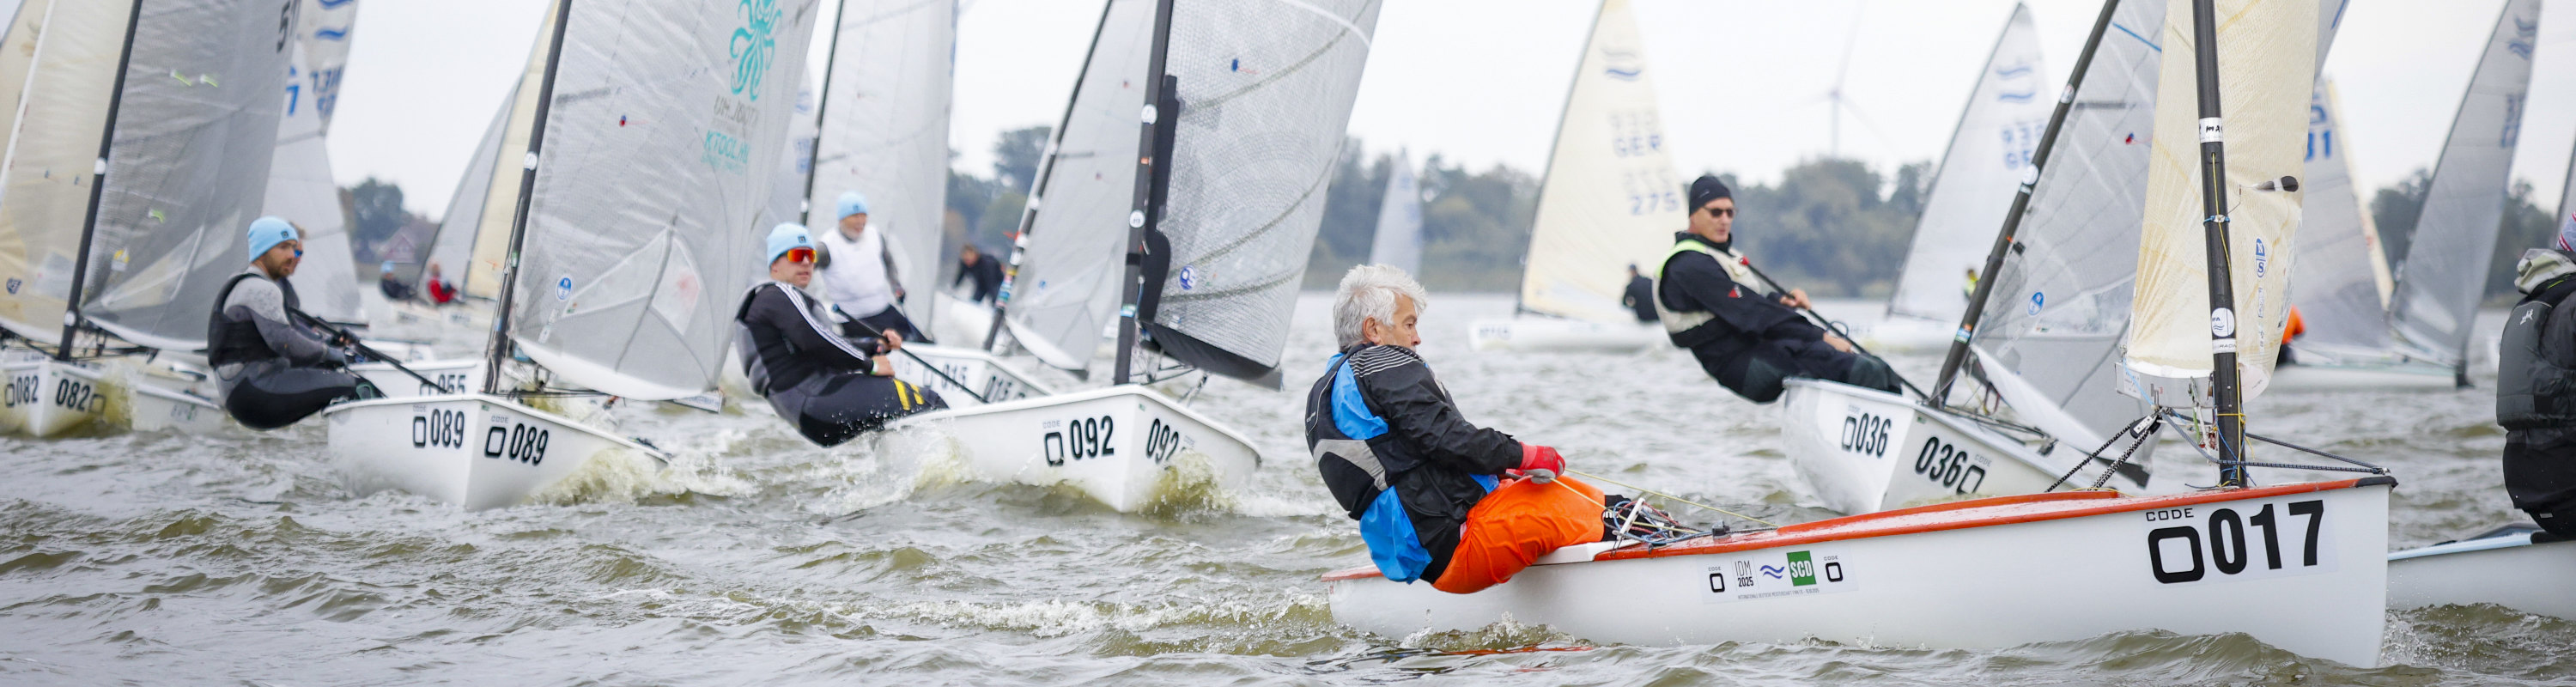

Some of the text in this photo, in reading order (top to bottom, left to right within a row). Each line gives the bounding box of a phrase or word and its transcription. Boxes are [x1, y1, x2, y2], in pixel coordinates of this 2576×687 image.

[1630, 192, 1680, 216] 275
[16, 375, 39, 404] 082
[55, 379, 90, 412] 082
[430, 408, 465, 449] 089
[1042, 420, 1061, 429] CODE
[1069, 415, 1115, 460] 092
[1856, 412, 1892, 459] 036
[508, 423, 549, 466] 089
[1915, 436, 1968, 489] 036
[2146, 508, 2194, 521] CODE
[2208, 500, 2324, 575] 017
[1735, 560, 1752, 576] IDM
[1737, 576, 1754, 587] 2025
[1789, 560, 1813, 579] SCD
